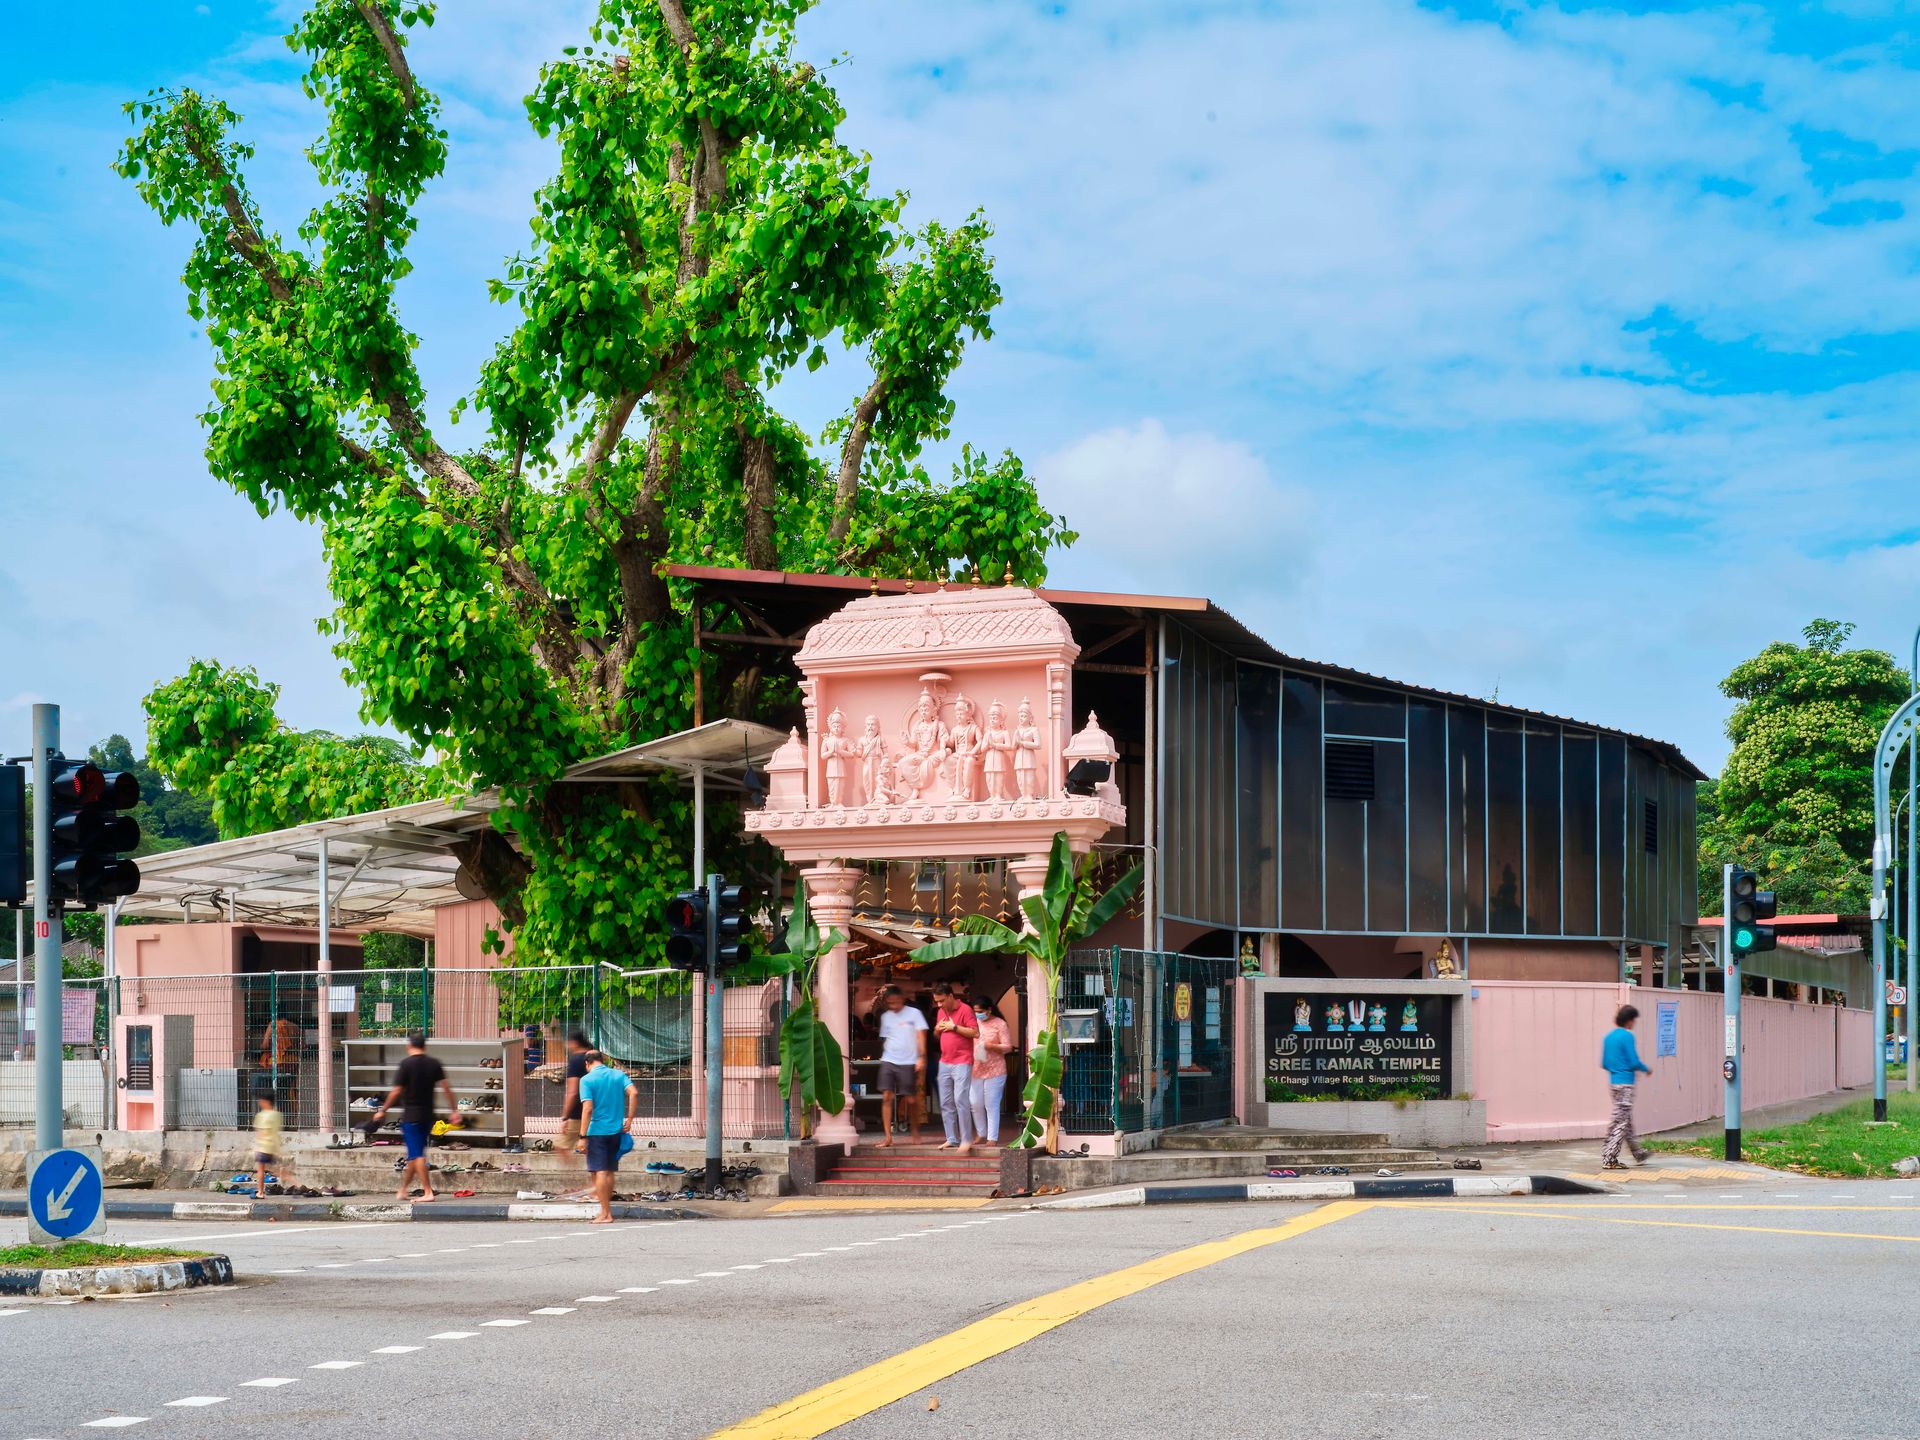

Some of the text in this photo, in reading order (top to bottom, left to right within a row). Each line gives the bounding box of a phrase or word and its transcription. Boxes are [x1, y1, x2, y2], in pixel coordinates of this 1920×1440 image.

[36, 921, 49, 938] 10
[1303, 1033, 1355, 1054] ராமர்
[1359, 1033, 1436, 1055] ஆலயம்
[1268, 1057, 1441, 1071] SREE RAMAR TEMPLE
[1280, 1075, 1309, 1086] Changi
[1311, 1075, 1340, 1085] Village
[1342, 1075, 1364, 1084] Road
[1368, 1074, 1409, 1085] Singapore
